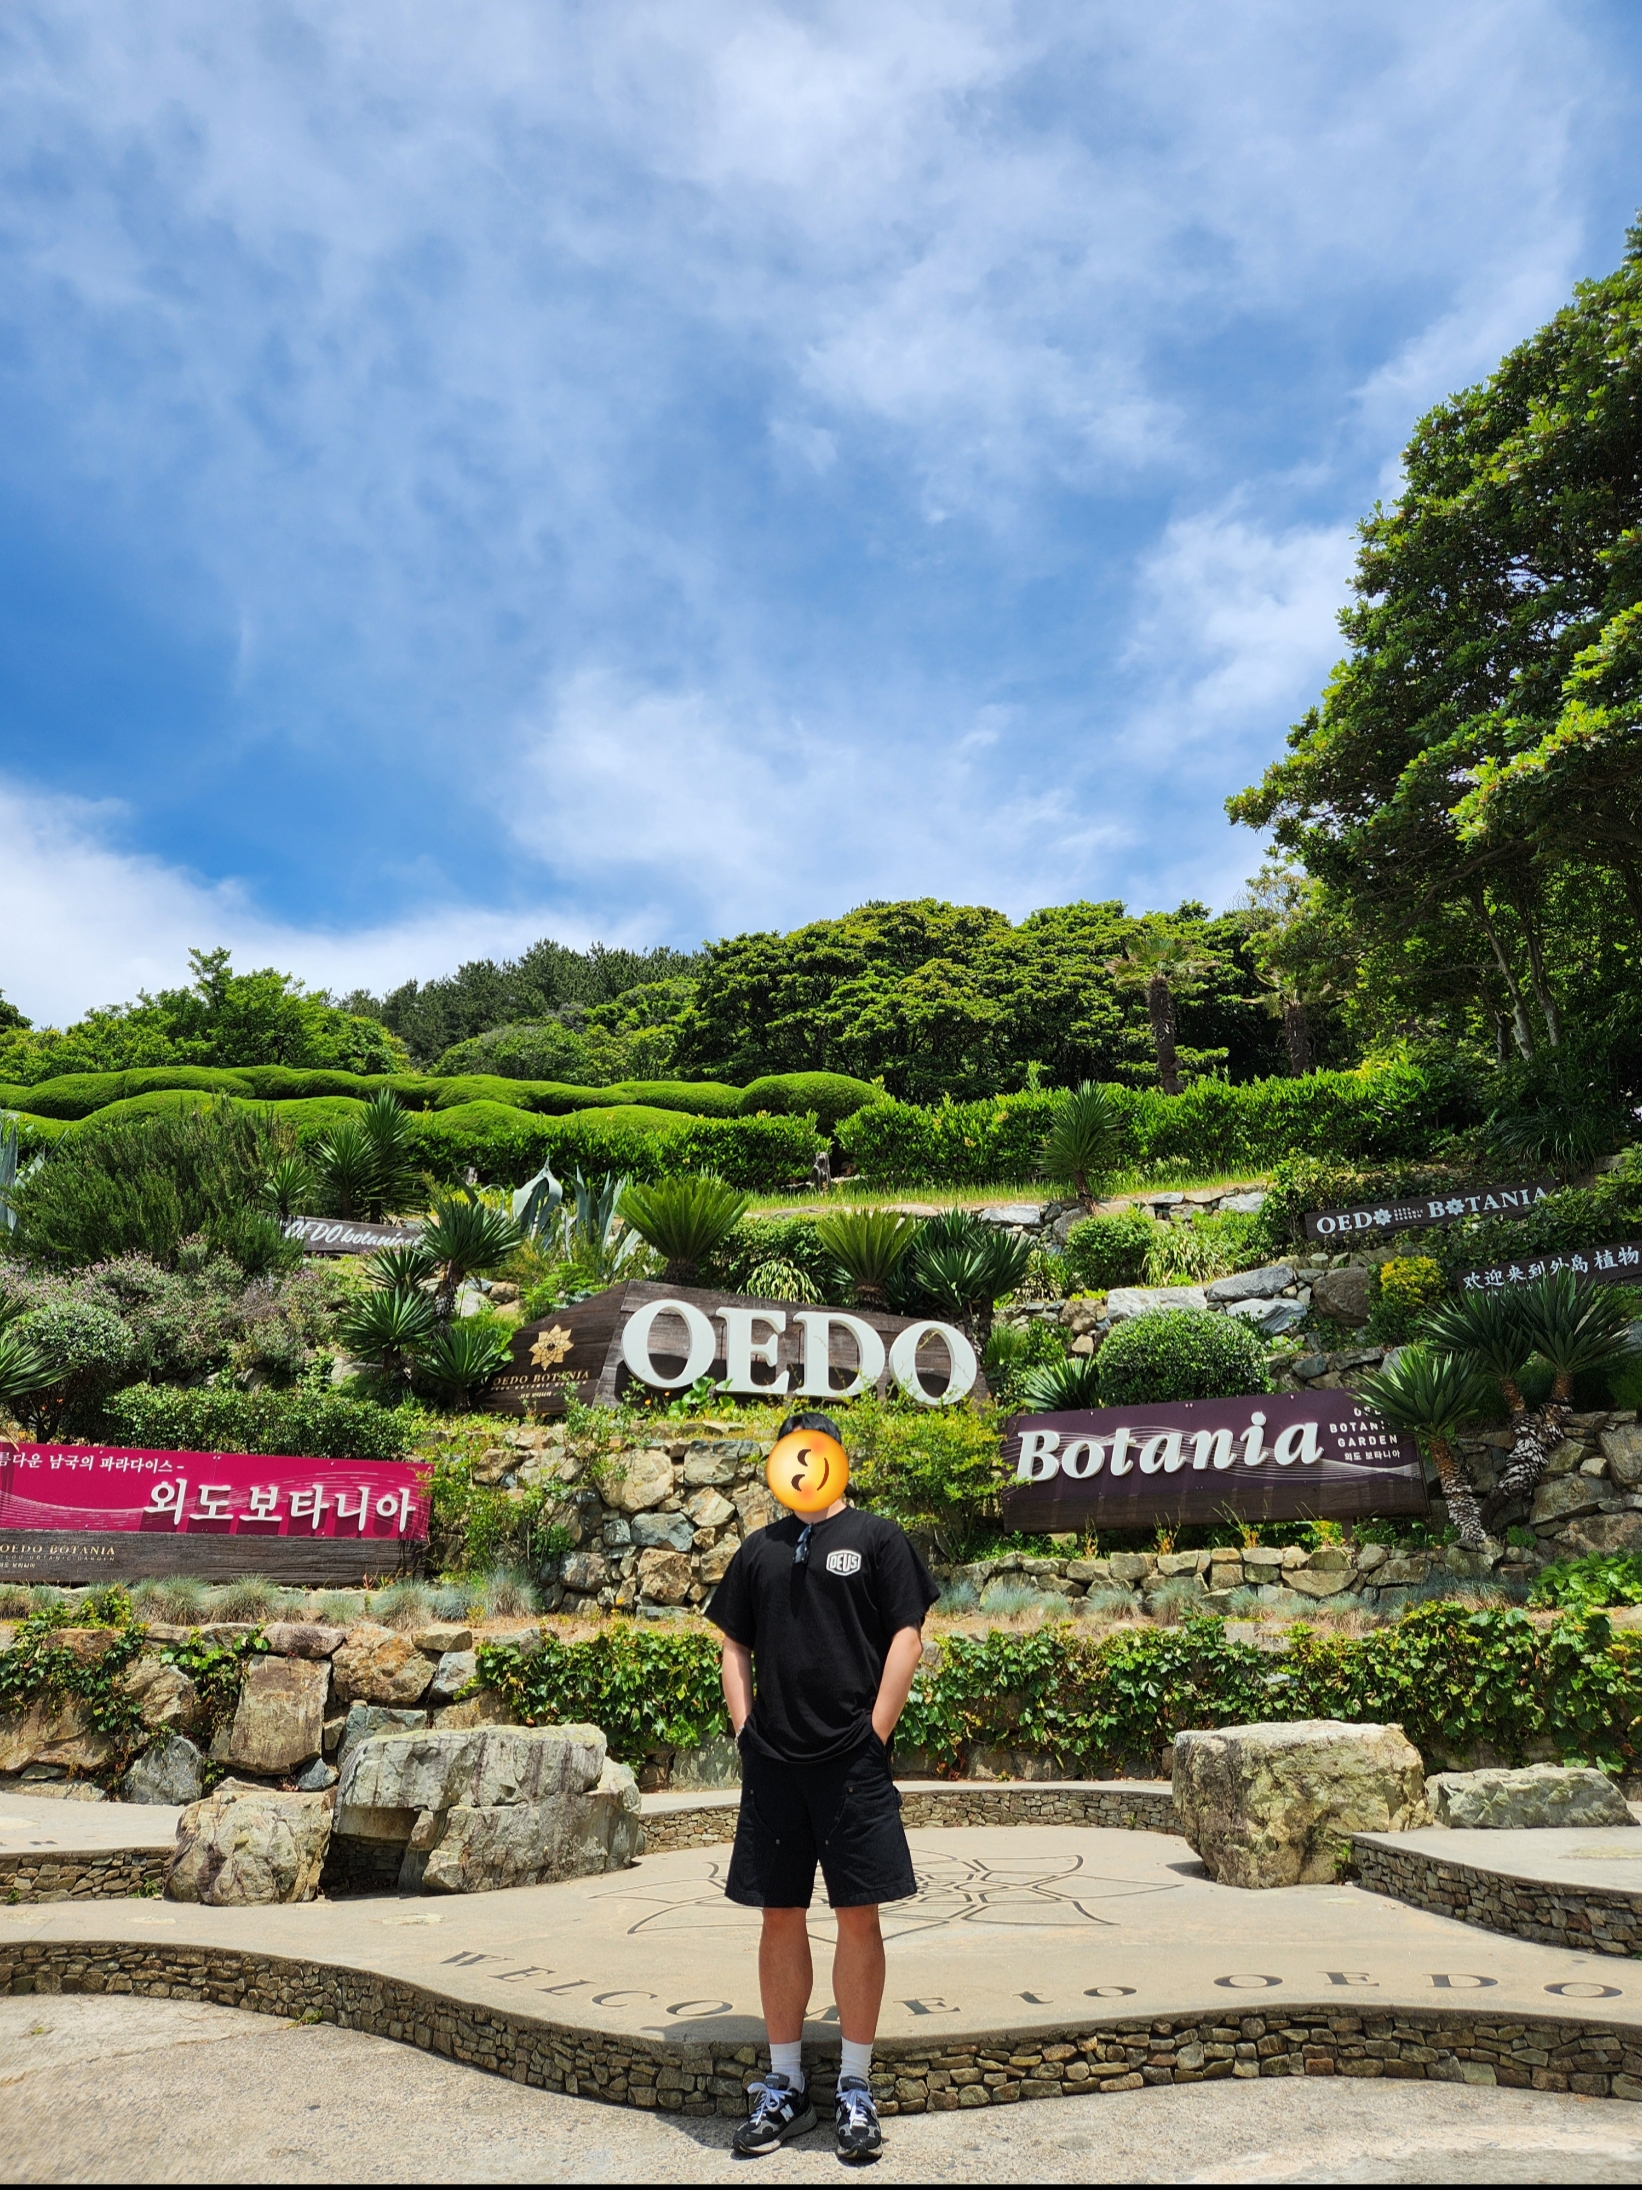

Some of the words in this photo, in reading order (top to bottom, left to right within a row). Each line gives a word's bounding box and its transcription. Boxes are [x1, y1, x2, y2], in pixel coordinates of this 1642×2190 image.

[622, 1299, 977, 1406] OEDO
[492, 1374, 528, 1387] OEDO
[1016, 1411, 1325, 1482] Botania
[1337, 1434, 1398, 1448] GARDEN
[49, 1453, 95, 1471] 남국의
[1344, 1451, 1362, 1461] 외도
[1365, 1449, 1401, 1460] 보타니아
[143, 1477, 416, 1533] 외도보타니아
[0, 1543, 43, 1554] OEDO
[49, 1544, 116, 1556] BOTANIA
[829, 1553, 859, 1572] DEUS
[1012, 1985, 1138, 2005] to
[1213, 1970, 1624, 1999] OEDO
